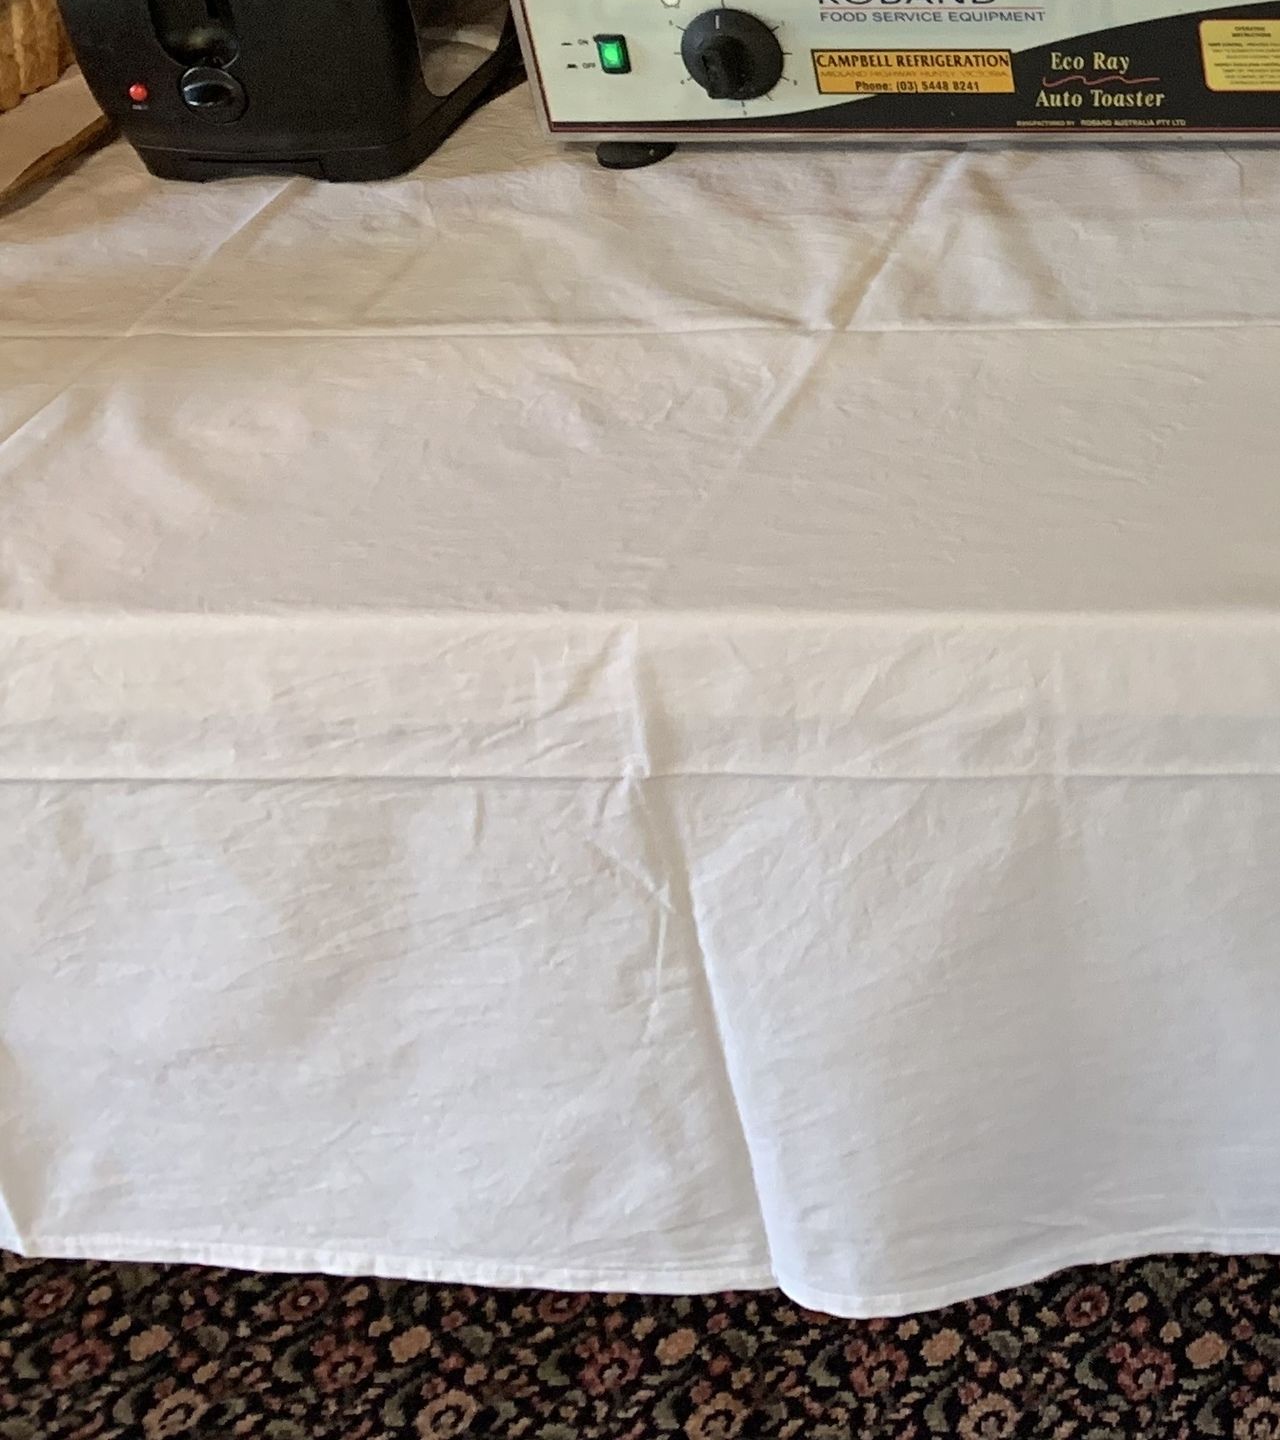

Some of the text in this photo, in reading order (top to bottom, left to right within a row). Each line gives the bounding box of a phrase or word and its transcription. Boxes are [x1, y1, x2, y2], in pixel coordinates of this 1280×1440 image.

[820, 12, 1046, 23] FOOD SERVICE EQUIPMENT
[816, 54, 1010, 68] CAMPBELL REFRIGERATION
[1051, 52, 1130, 74] Eco Ray
[855, 81, 980, 92] Phone: (03) 5448 8241
[1035, 90, 1165, 107] Auto Toaster
